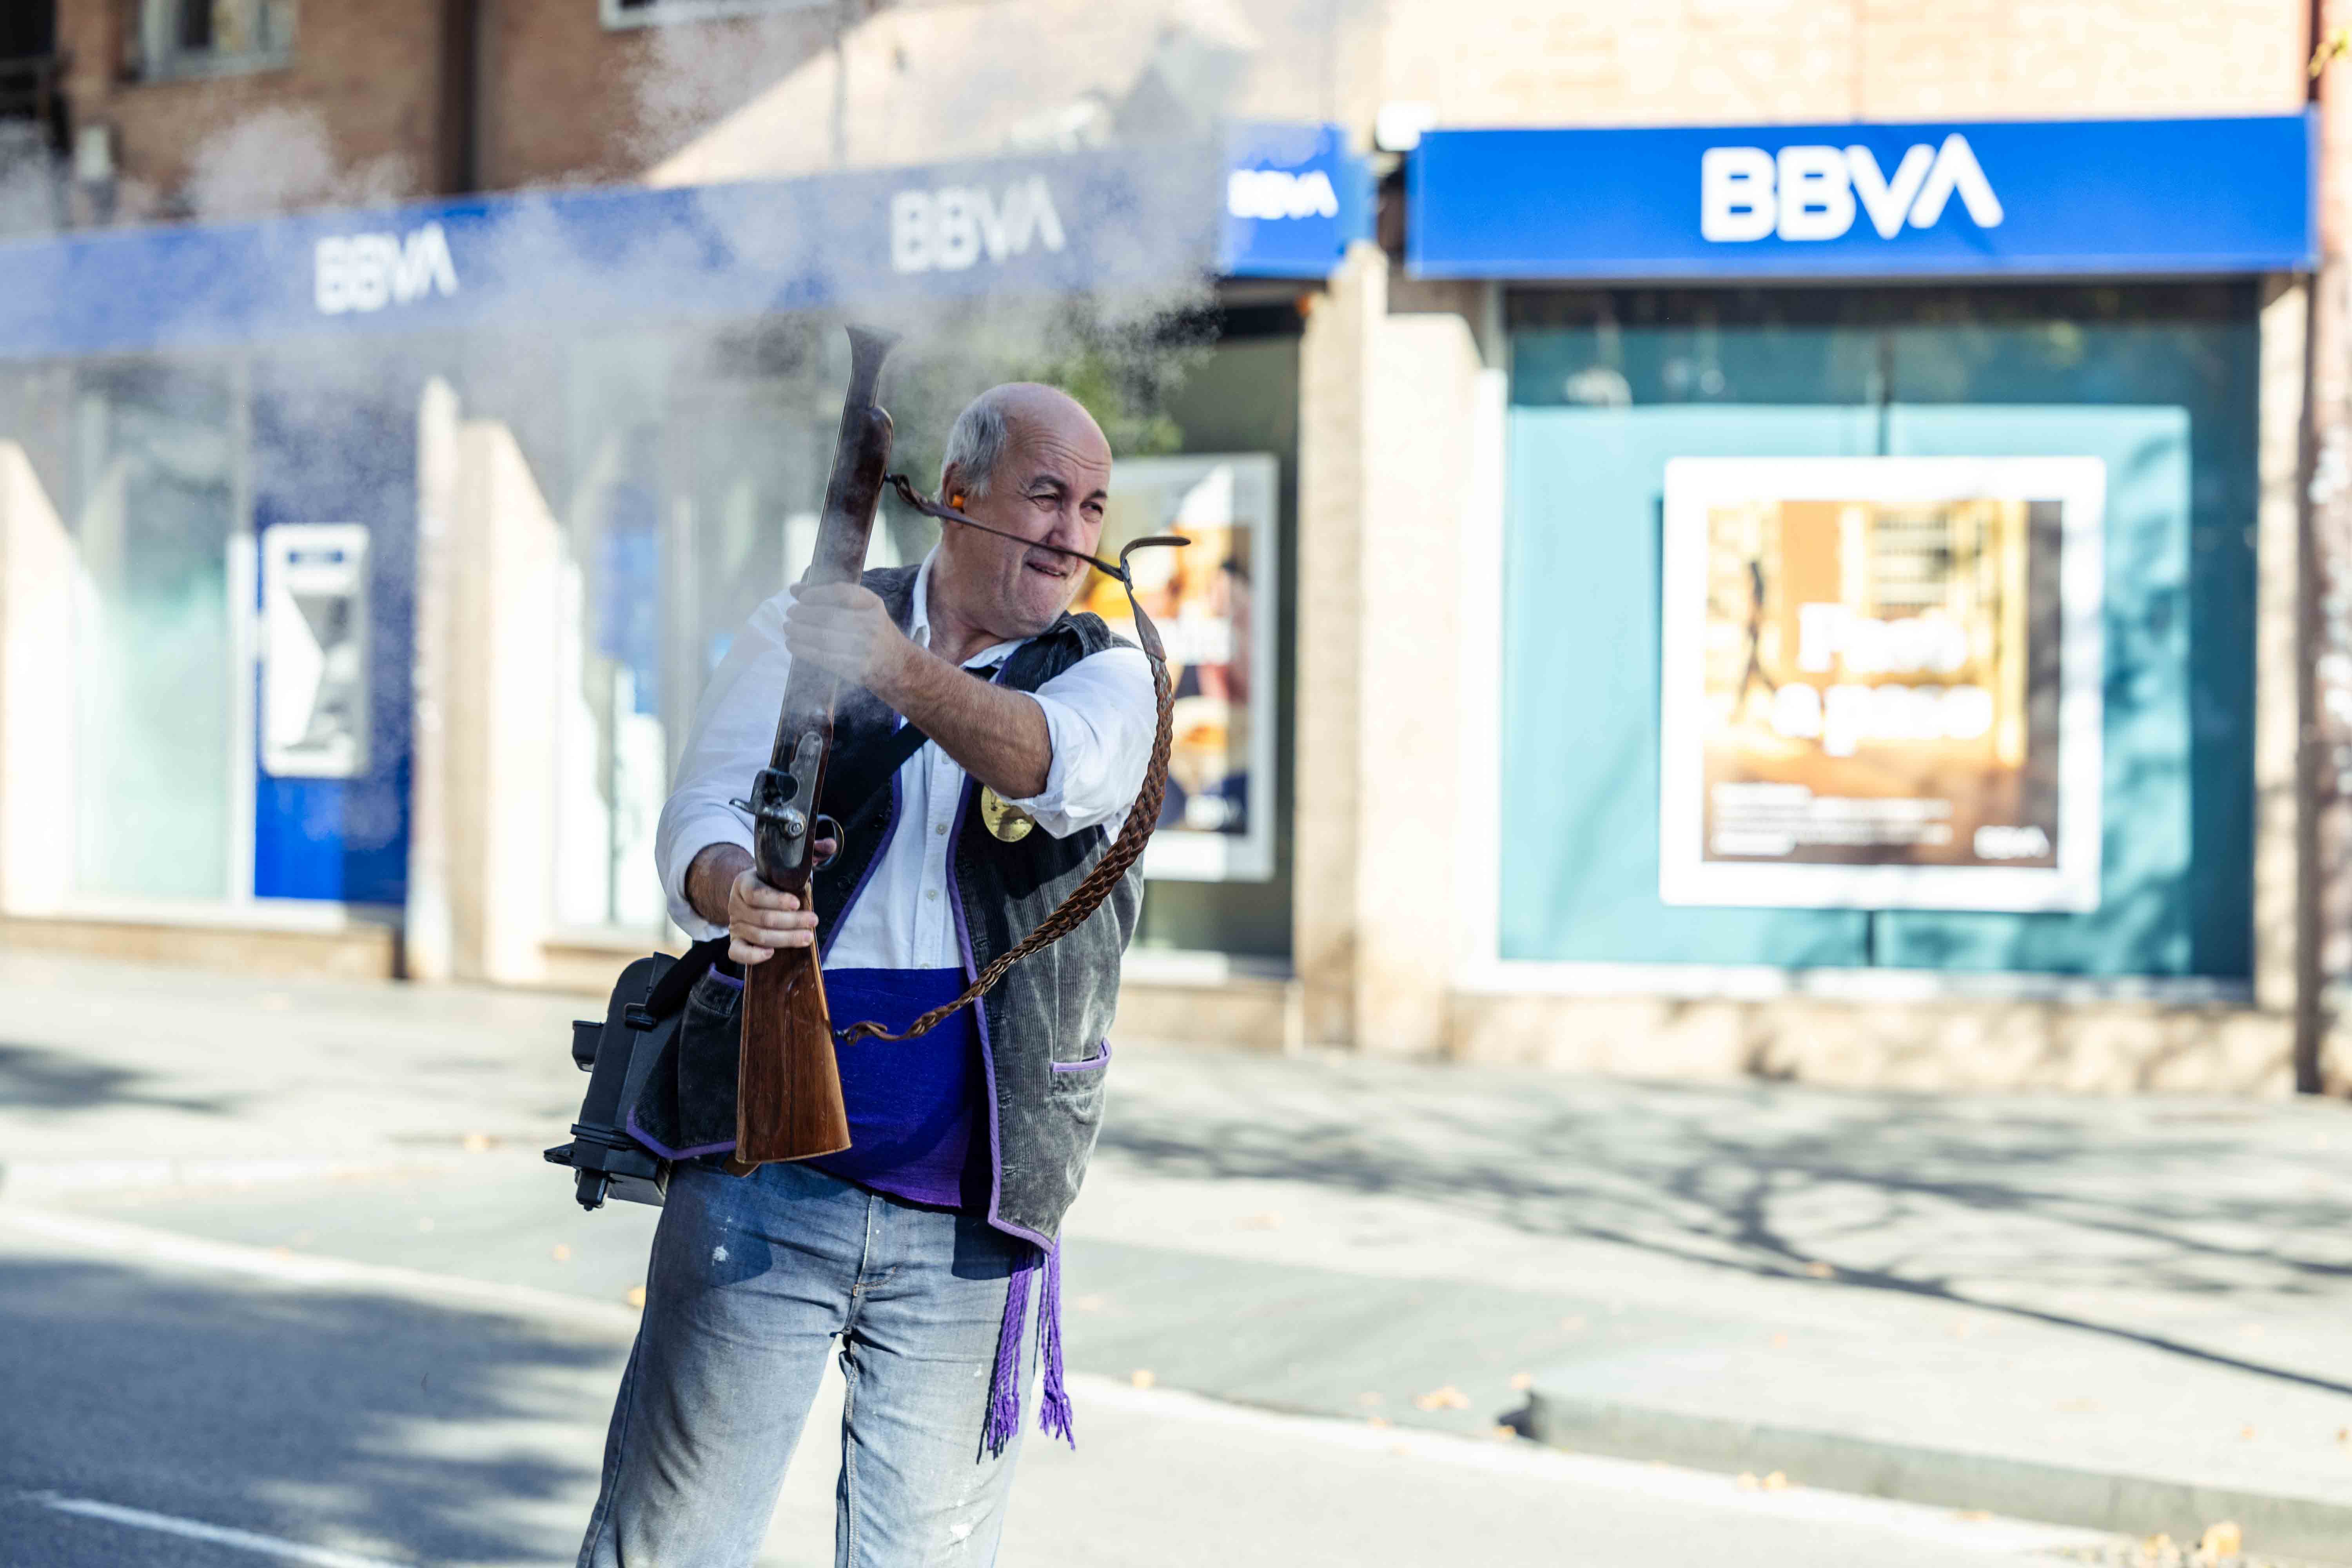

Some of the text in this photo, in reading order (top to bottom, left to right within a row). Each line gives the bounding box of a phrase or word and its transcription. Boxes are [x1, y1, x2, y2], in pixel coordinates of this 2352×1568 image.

[890, 176, 1066, 274] BBVA
[1701, 132, 2004, 242] BBVA
[315, 221, 459, 315] BBVA
